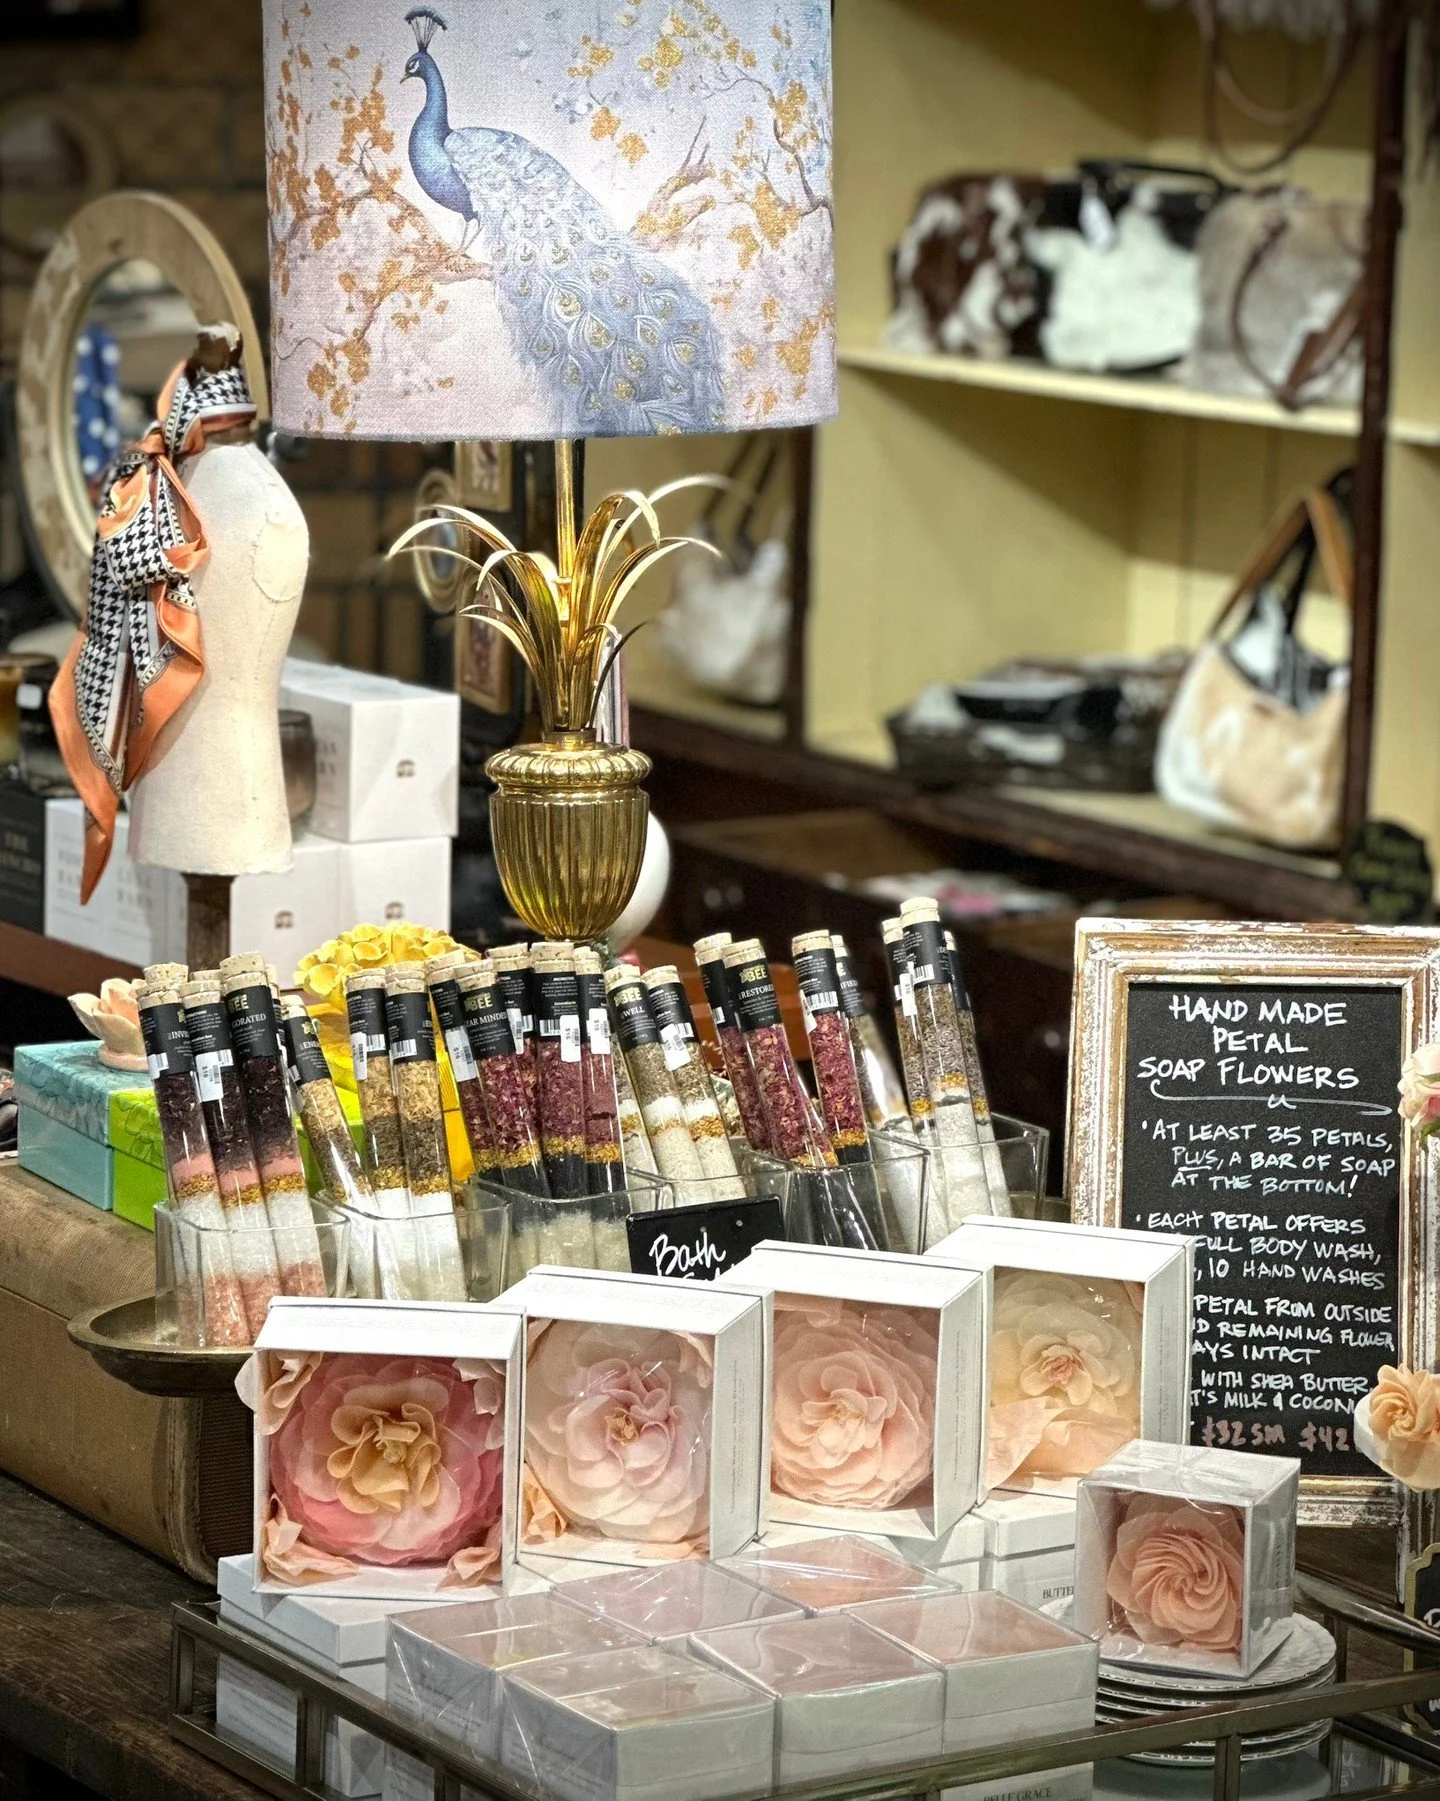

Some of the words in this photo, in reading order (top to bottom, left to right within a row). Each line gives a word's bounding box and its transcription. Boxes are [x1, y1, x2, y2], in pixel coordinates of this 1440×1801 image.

[1170, 995, 1248, 1024] HAND
[1259, 999, 1347, 1026] MADE
[1213, 1026, 1308, 1053] PETAL
[1138, 1056, 1206, 1081] SOAP
[1217, 1057, 1359, 1089] FLOWERS
[1153, 1119, 1180, 1141] AT
[1190, 1123, 1256, 1142] LEAST
[1267, 1126, 1302, 1145] 35
[1312, 1128, 1393, 1152] PETALS,
[1229, 1153, 1242, 1167] A
[1250, 1152, 1297, 1169] BAR
[1302, 1154, 1332, 1171] OF
[1341, 1157, 1396, 1175] SOAP
[1171, 1174, 1198, 1189] AT
[1209, 1175, 1252, 1191] THE
[1261, 1175, 1358, 1199] BOTTOM!
[1148, 1213, 1203, 1229] EACH
[1211, 1211, 1278, 1231] PETAL
[1285, 1214, 1366, 1235] OFFERS
[648, 1231, 727, 1277] Bath
[1249, 1235, 1307, 1261] BODY
[1314, 1240, 1382, 1266] WASH,
[1243, 1259, 1296, 1280] HAND
[1302, 1267, 1386, 1290] WASHES
[1194, 1294, 1259, 1316] PETAL
[1264, 1297, 1316, 1319] FROM
[1324, 1303, 1393, 1323] OUTSIDE
[1217, 1321, 1333, 1345] REMAINING
[1340, 1328, 1395, 1352] FLOWER
[1243, 1344, 1321, 1365] INTACT
[1201, 1369, 1243, 1389] WITH
[1251, 1372, 1294, 1391] SHEA
[1191, 1389, 1218, 1407] T'S
[1224, 1391, 1268, 1410] MILK
[1298, 1421, 1350, 1453] $42
